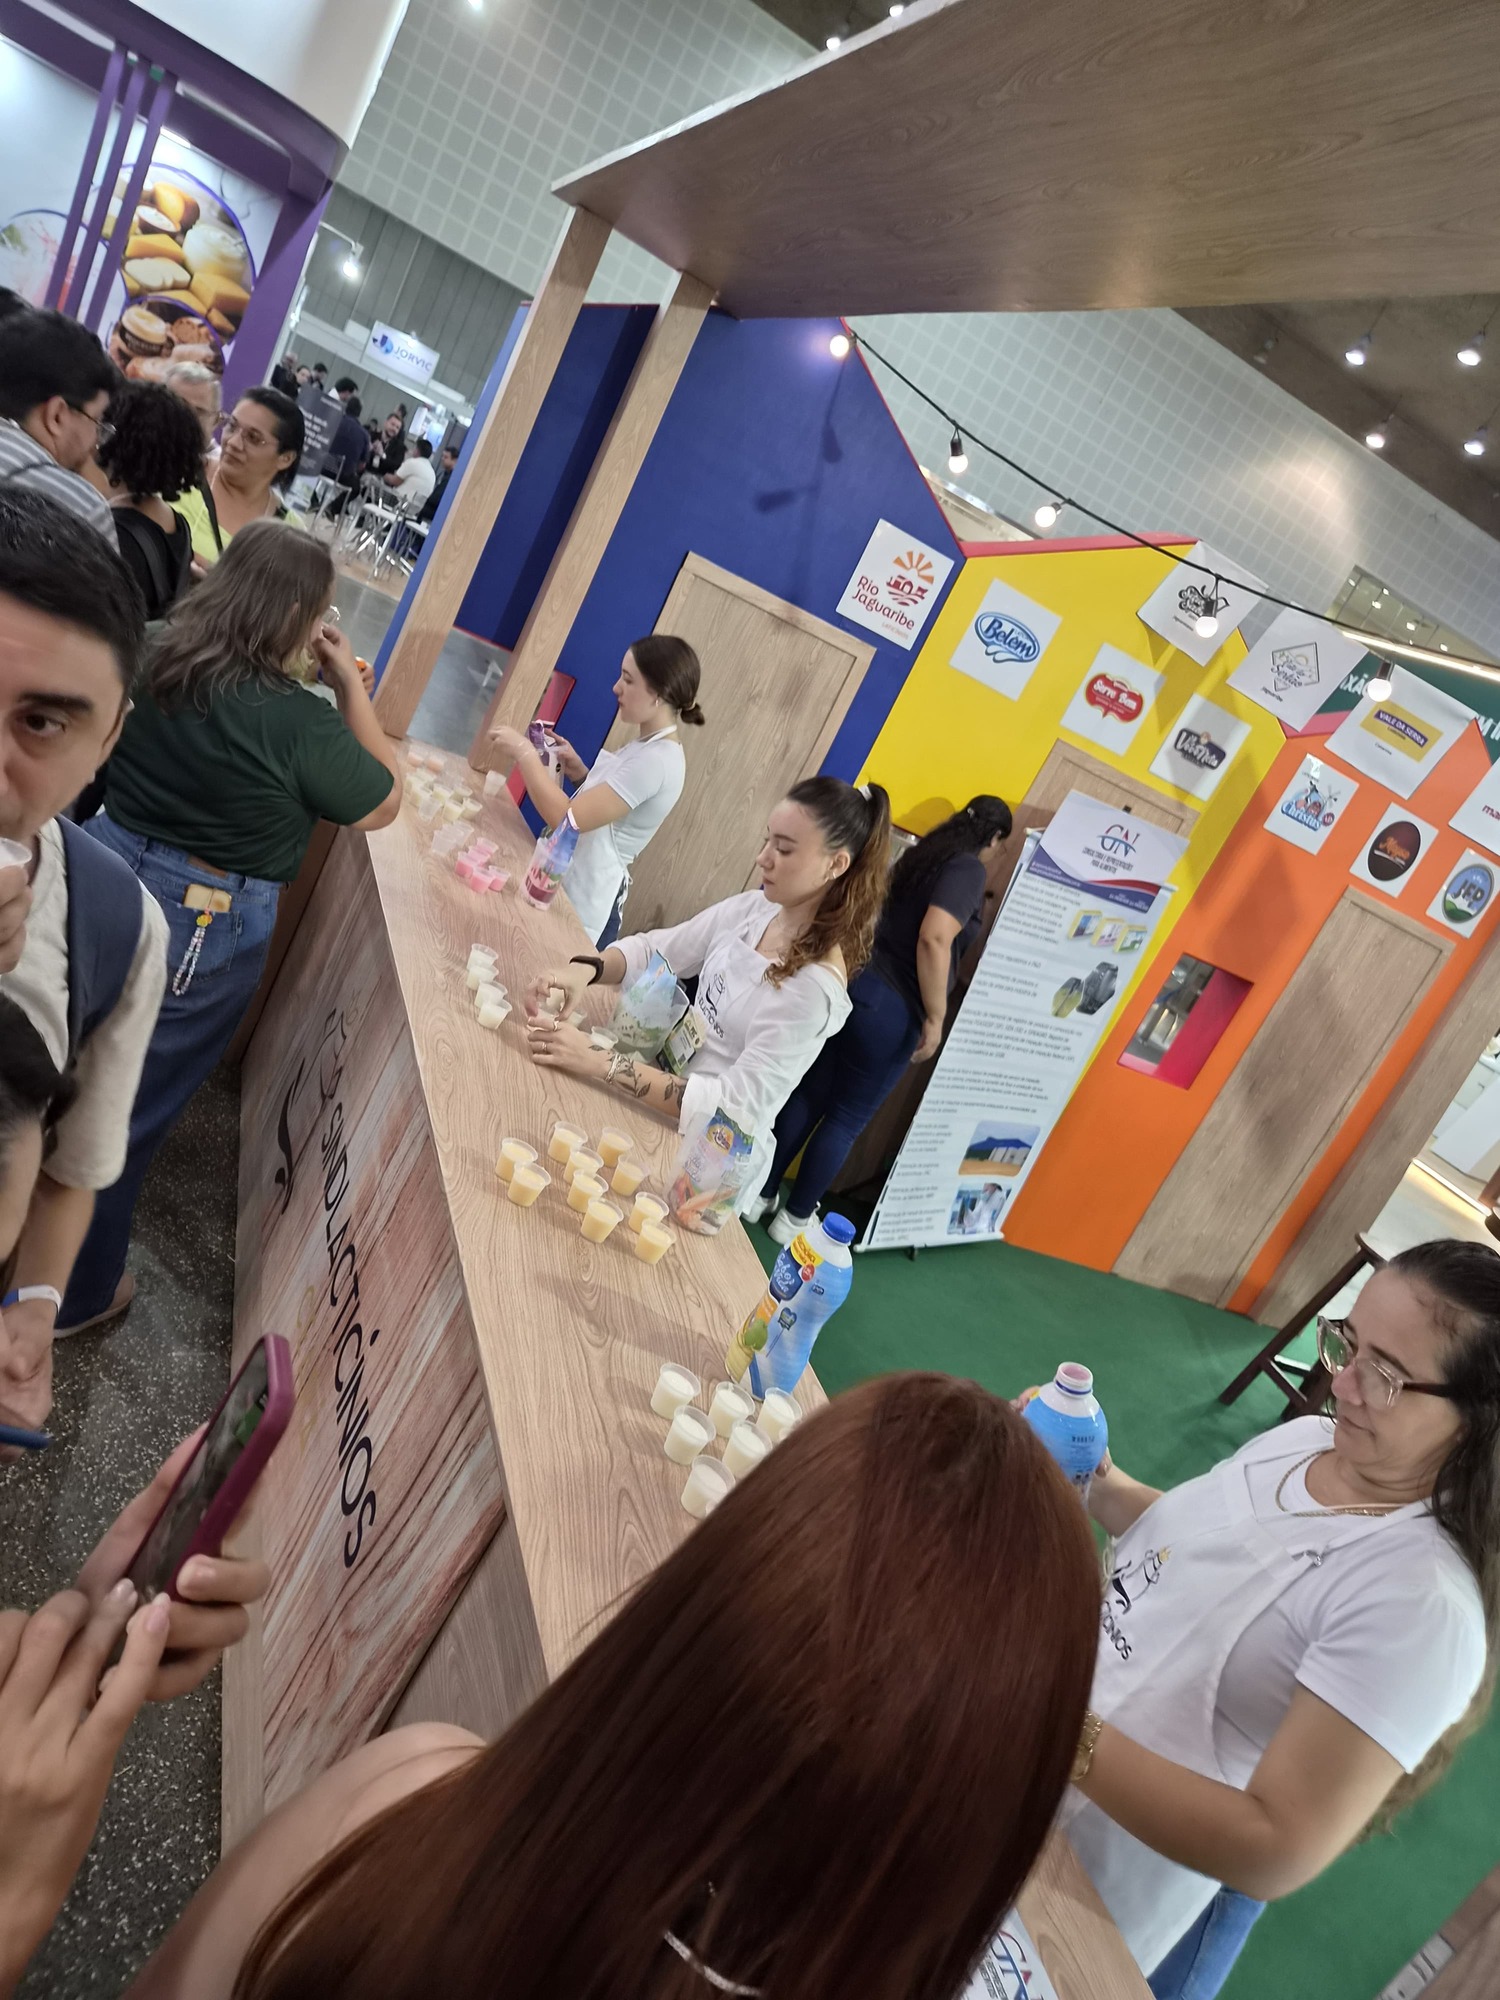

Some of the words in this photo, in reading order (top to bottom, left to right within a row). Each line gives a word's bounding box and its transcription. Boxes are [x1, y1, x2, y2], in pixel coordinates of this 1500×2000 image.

[394, 346, 433, 373] JORVIC
[857, 575, 879, 596] Rio
[852, 588, 915, 631] Jaguaribe
[1378, 711, 1397, 728] VALE
[1404, 726, 1426, 747] SERRA
[1281, 800, 1321, 831] Christus
[321, 1102, 380, 1569] SINDLACTICÍNIOS
